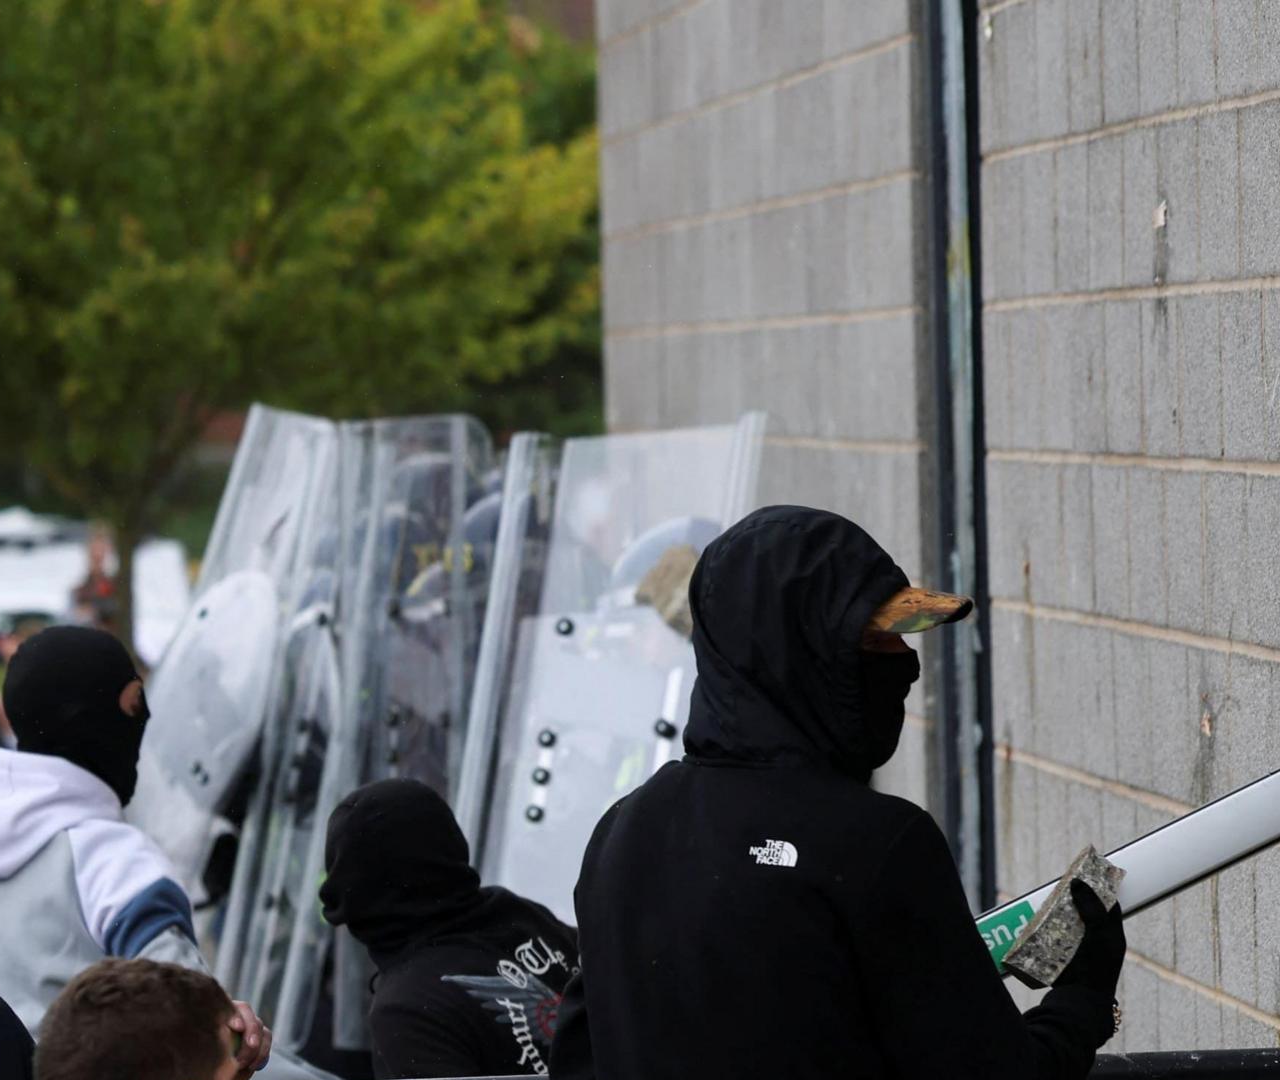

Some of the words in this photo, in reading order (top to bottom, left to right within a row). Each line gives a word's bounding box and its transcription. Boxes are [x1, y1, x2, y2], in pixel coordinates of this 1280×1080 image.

[765, 839, 784, 849] THE
[749, 846, 782, 858] NORTH
[756, 855, 780, 866] FACE
